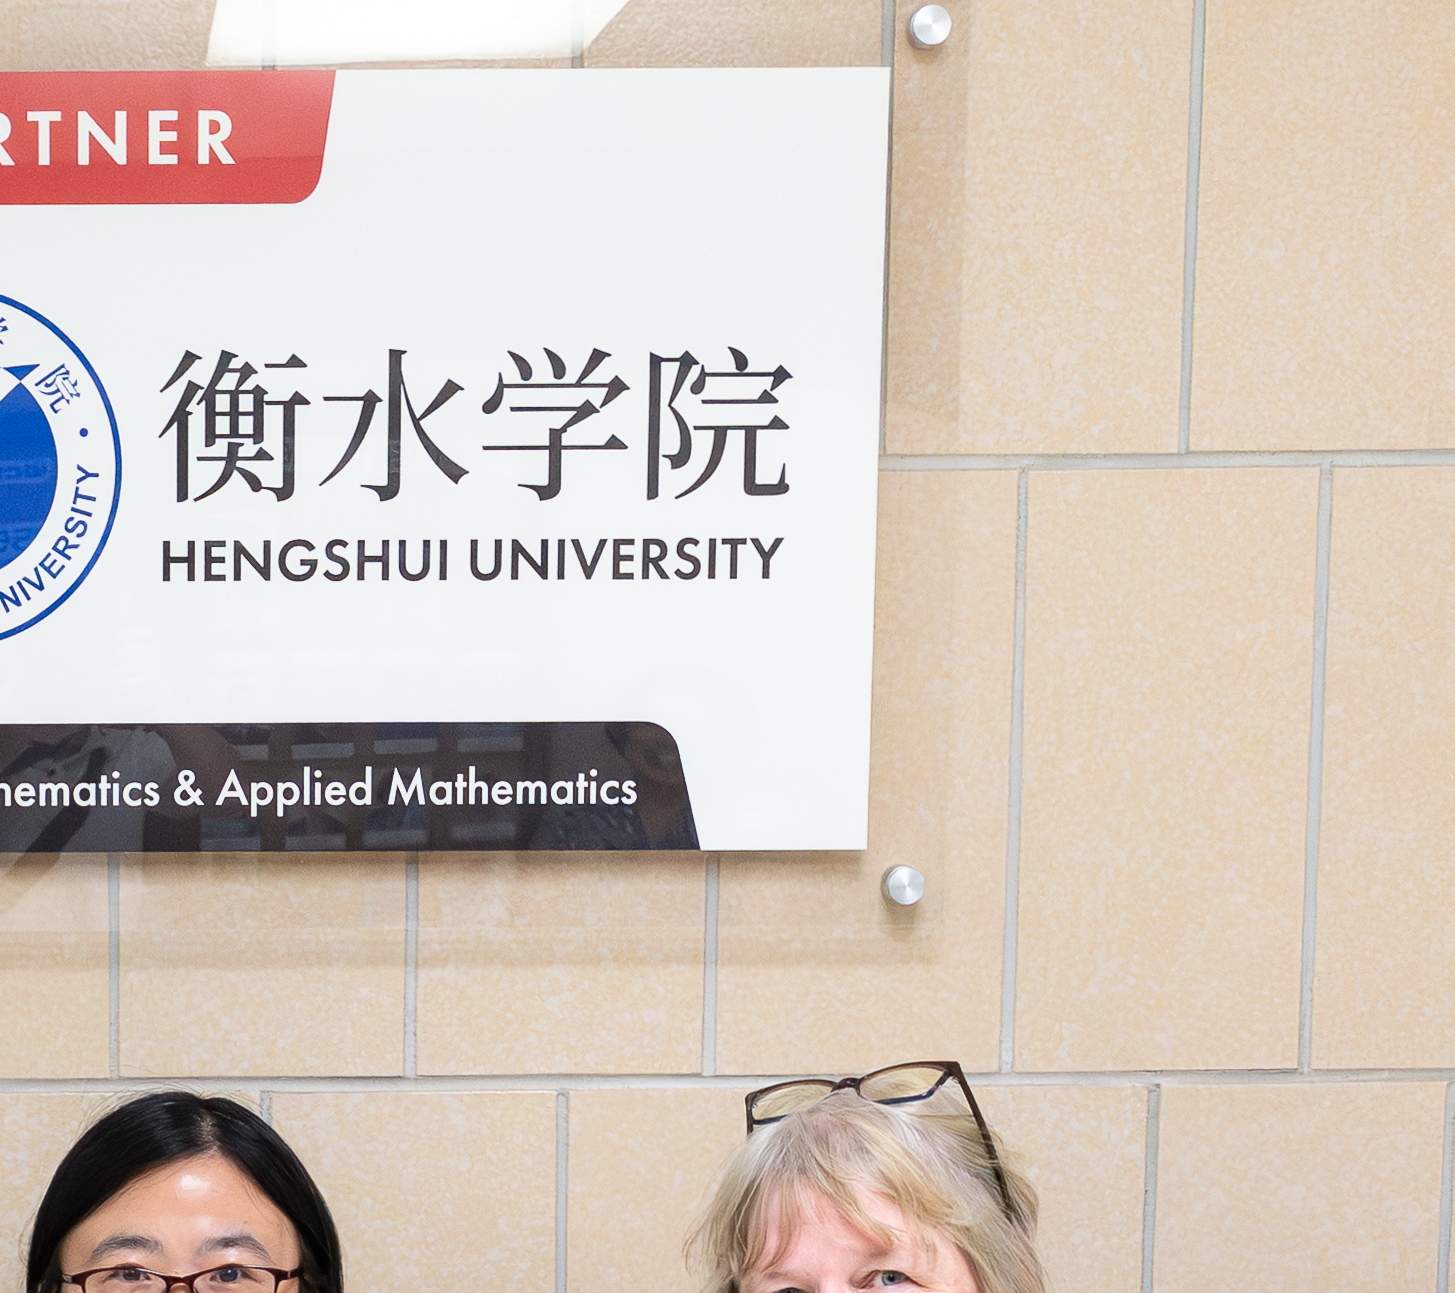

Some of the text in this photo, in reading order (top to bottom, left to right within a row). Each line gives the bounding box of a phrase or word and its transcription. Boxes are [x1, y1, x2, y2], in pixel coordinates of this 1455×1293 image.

[158, 346, 793, 503] 衡水学院
[162, 537, 785, 582] HENGSHUI UNIVERSITY
[173, 769, 205, 807] &
[215, 765, 373, 818] Applied
[387, 765, 638, 806] Mathematics
